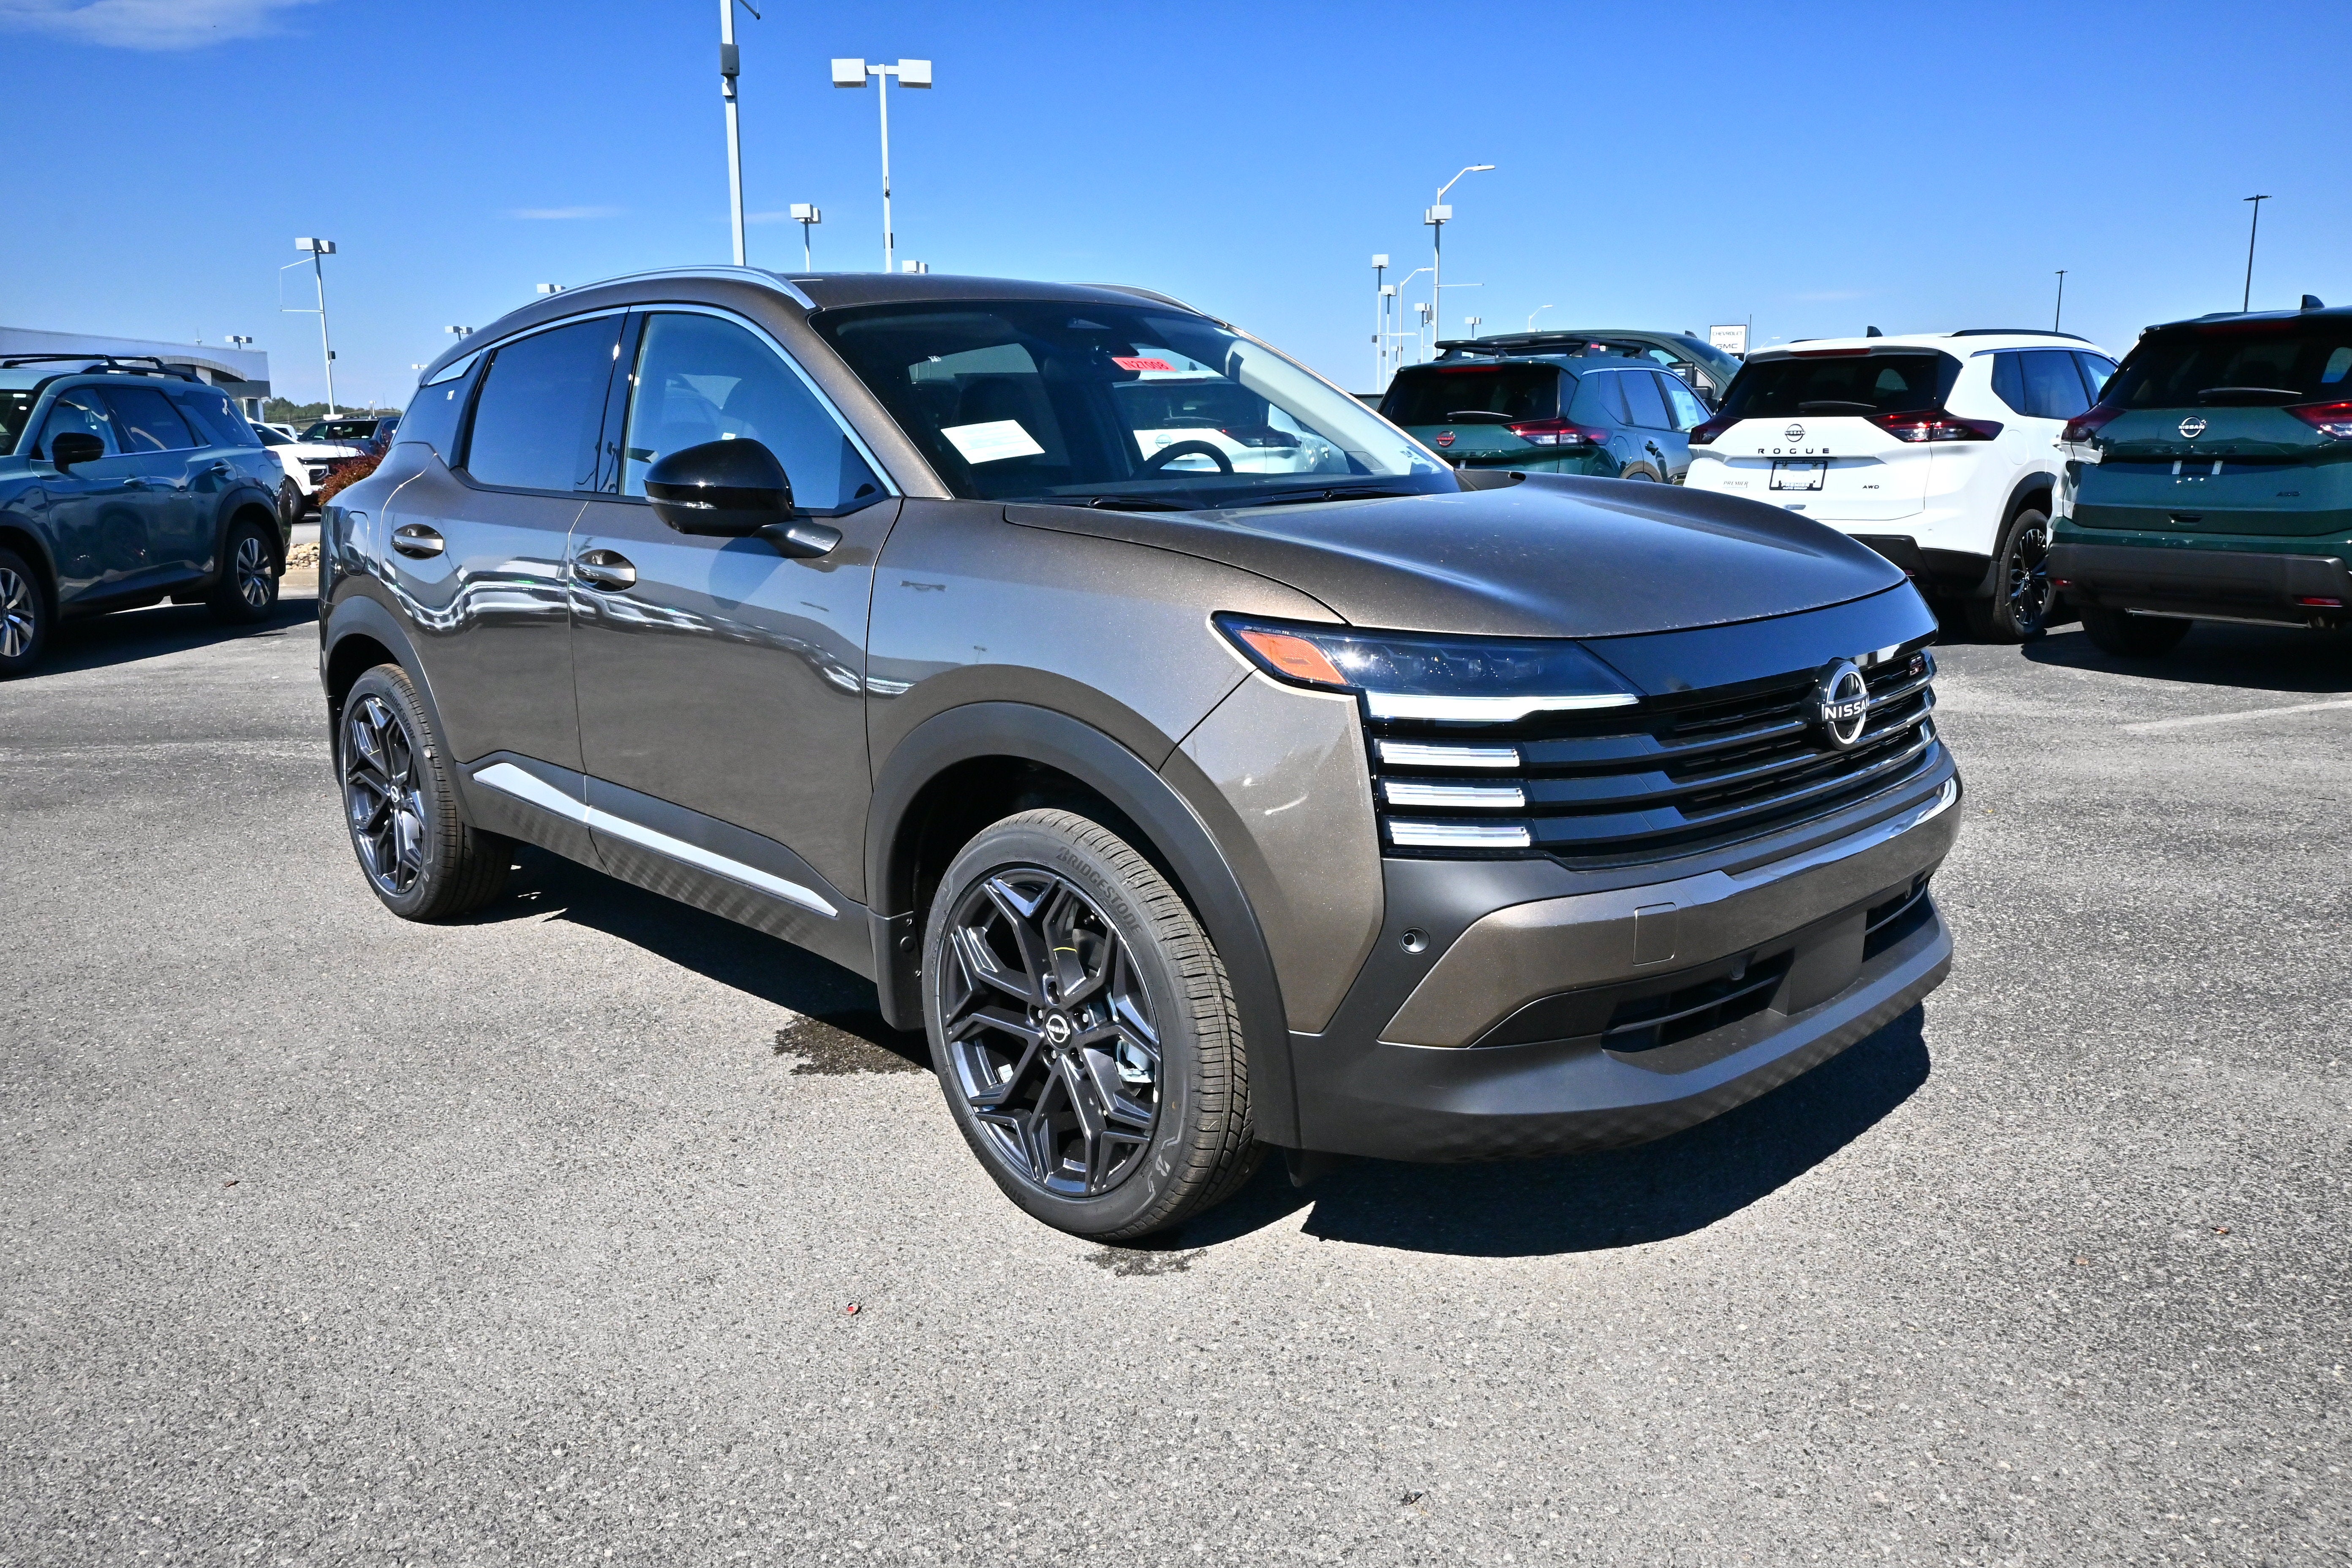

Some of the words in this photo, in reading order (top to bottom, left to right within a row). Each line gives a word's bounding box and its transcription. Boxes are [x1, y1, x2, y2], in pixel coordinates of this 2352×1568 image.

[1122, 361, 1169, 370] N27008
[1825, 697, 1870, 719] NISSAN
[1056, 846, 1143, 936] BRIDGESTONE
[1046, 1024, 1070, 1035] NISSAN
